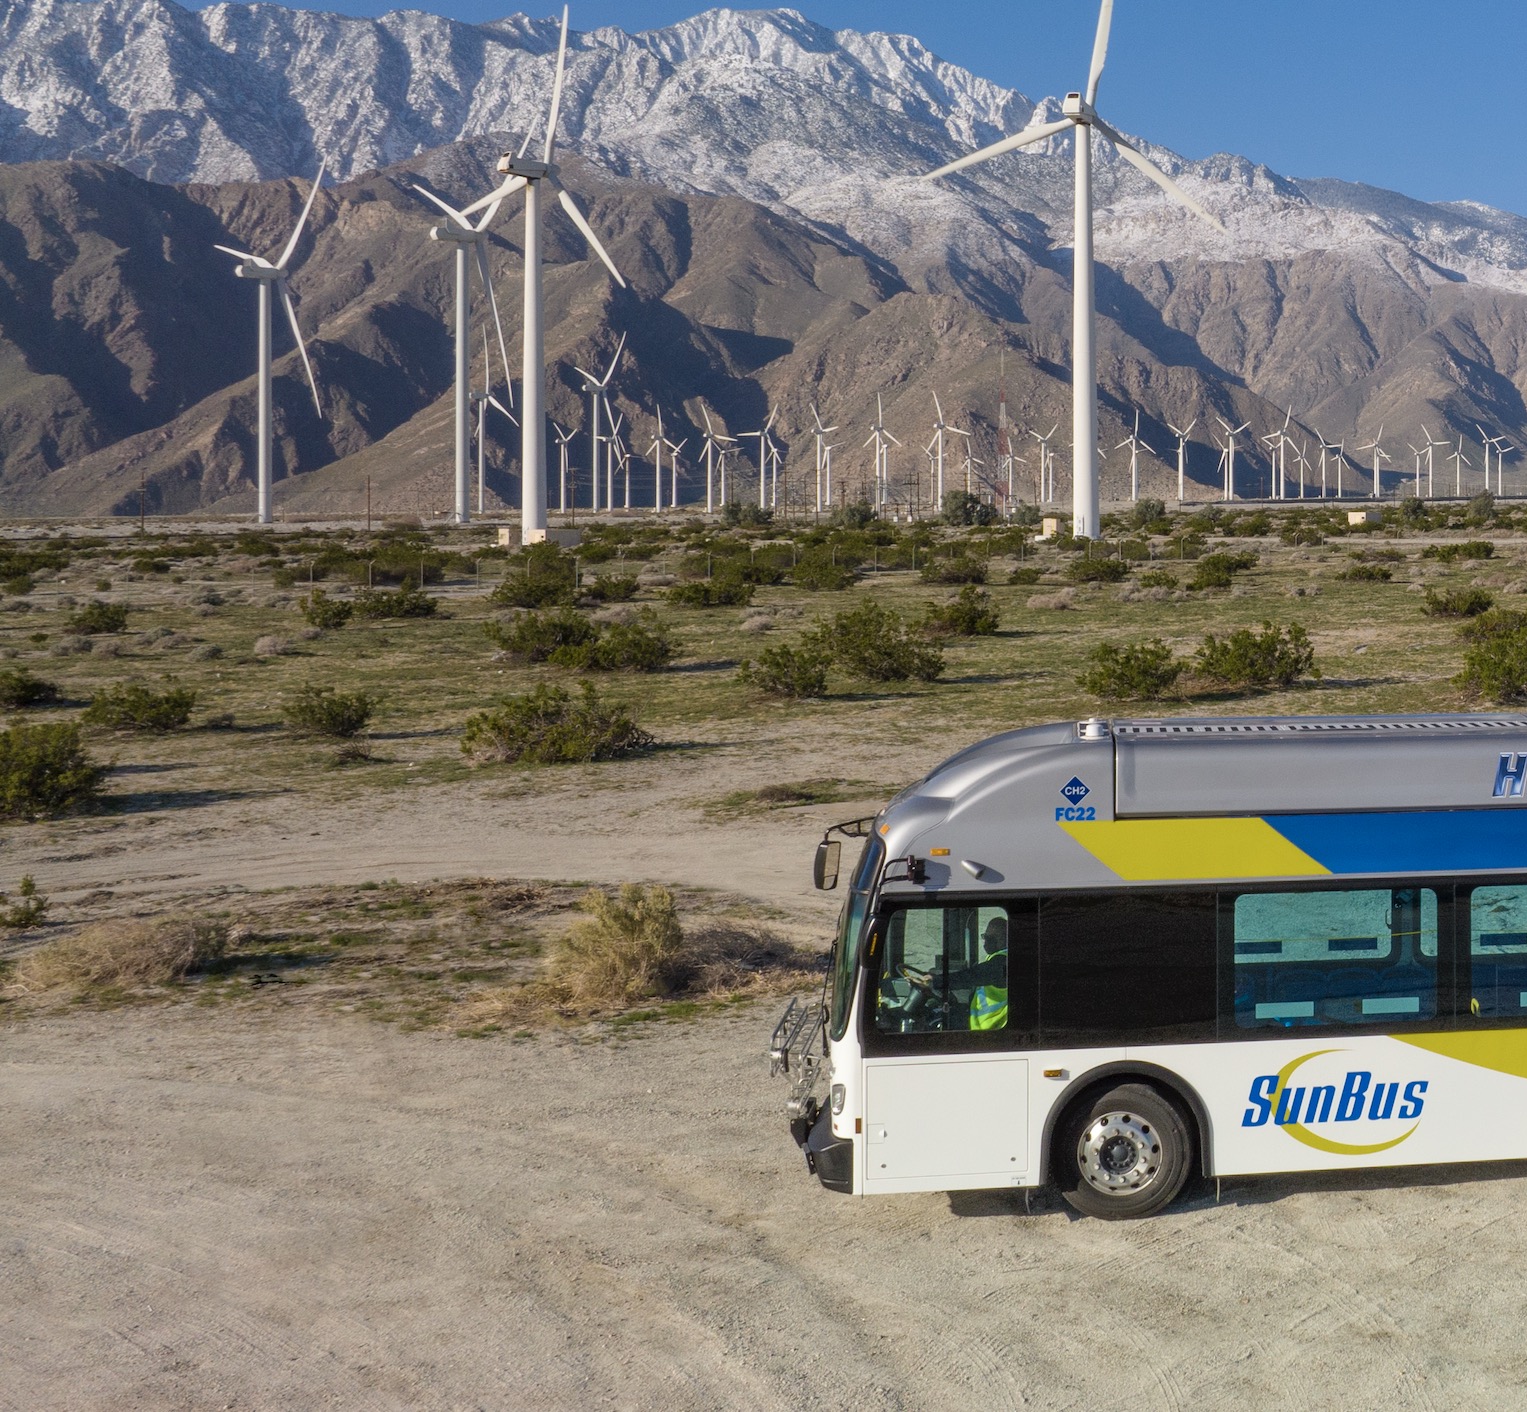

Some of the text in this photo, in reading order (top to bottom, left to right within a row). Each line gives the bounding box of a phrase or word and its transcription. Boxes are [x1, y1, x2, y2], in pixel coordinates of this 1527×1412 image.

[1064, 786, 1086, 796] CH2
[1055, 806, 1096, 821] FC22
[1241, 1071, 1429, 1127] SunBus
